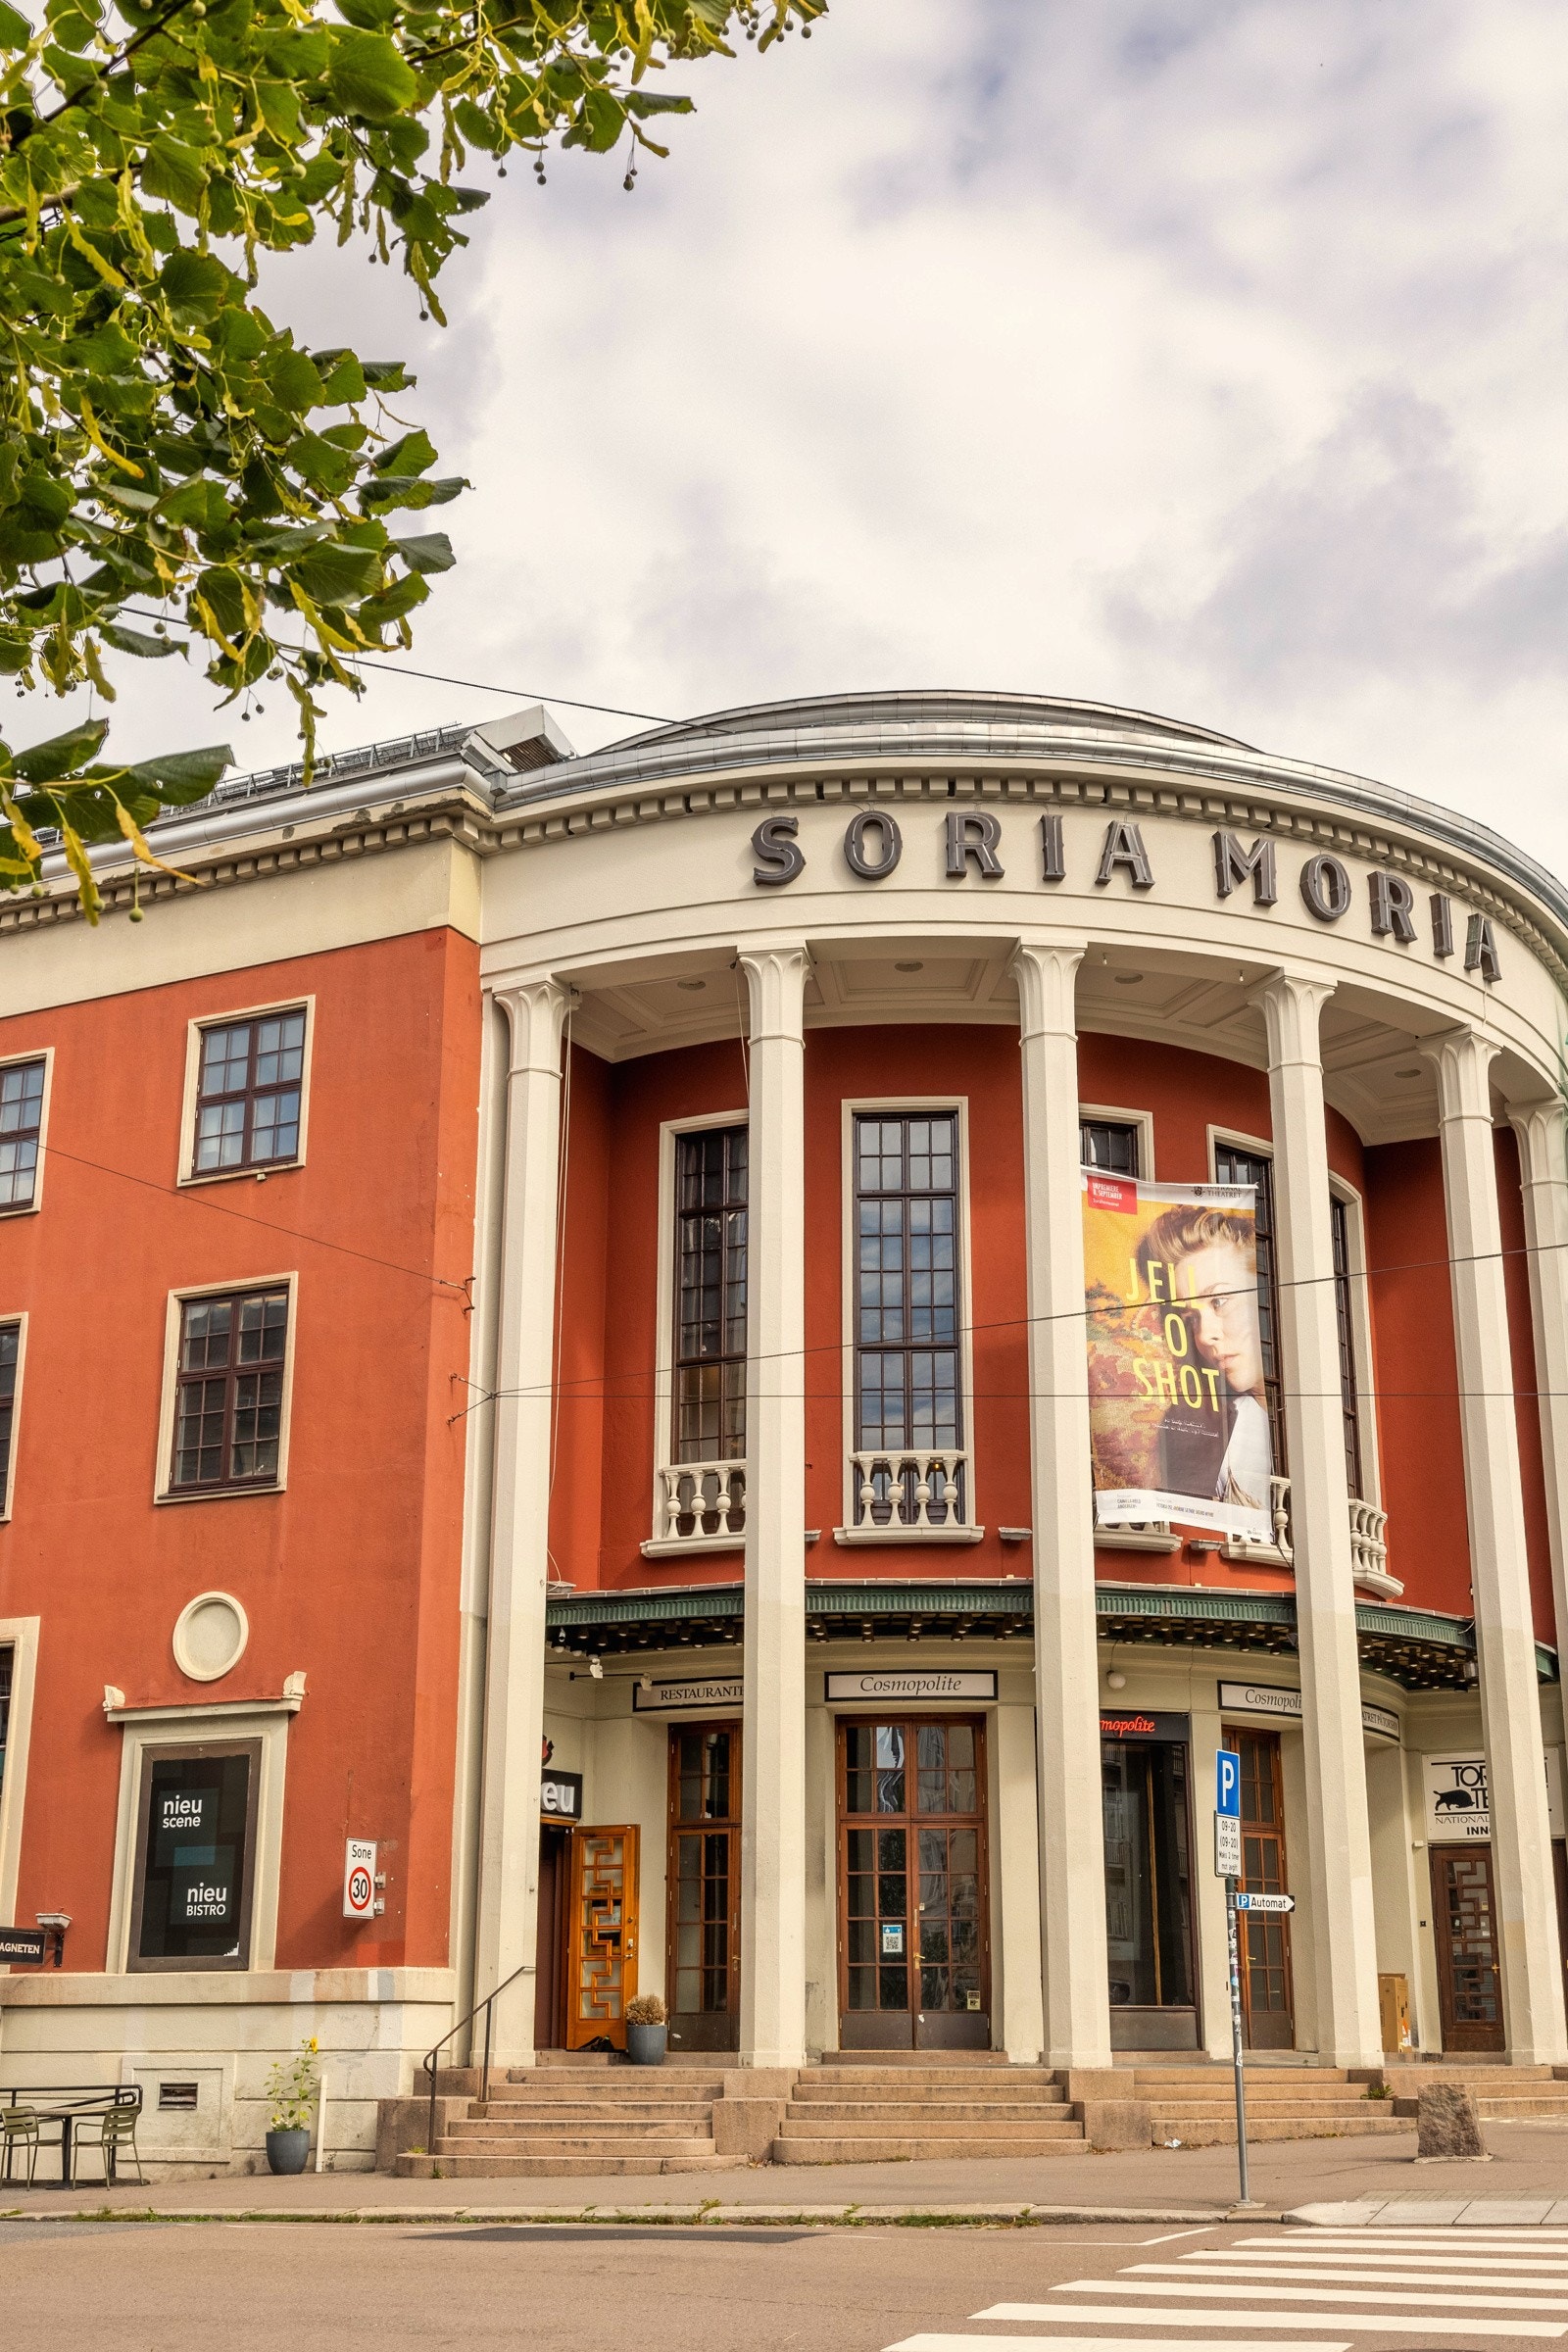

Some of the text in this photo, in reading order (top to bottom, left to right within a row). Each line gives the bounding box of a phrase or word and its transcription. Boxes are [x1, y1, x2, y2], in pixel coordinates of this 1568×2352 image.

[751, 809, 1502, 982] SORIA MORIA
[1098, 1190, 1123, 1200] SEPTEMBER
[1207, 1190, 1242, 1199] THEATRET
[1126, 1257, 1205, 1310] JELL
[1164, 1313, 1188, 1357] O
[1132, 1357, 1220, 1412] SHOT
[860, 1676, 962, 1696] Cosmopolite
[1245, 1689, 1302, 1712] Cosmopoli
[1221, 1759, 1235, 1807] P
[163, 1794, 203, 1815] nieu
[162, 1816, 202, 1829] scene
[1221, 1820, 1237, 1833] 09-20
[1466, 1826, 1491, 1836] INN
[351, 1844, 372, 1859] Sone
[187, 1882, 227, 1903] nieu
[352, 1877, 368, 1899] 30
[186, 1904, 226, 1916] BISTRO
[1250, 1896, 1287, 1909] Automat
